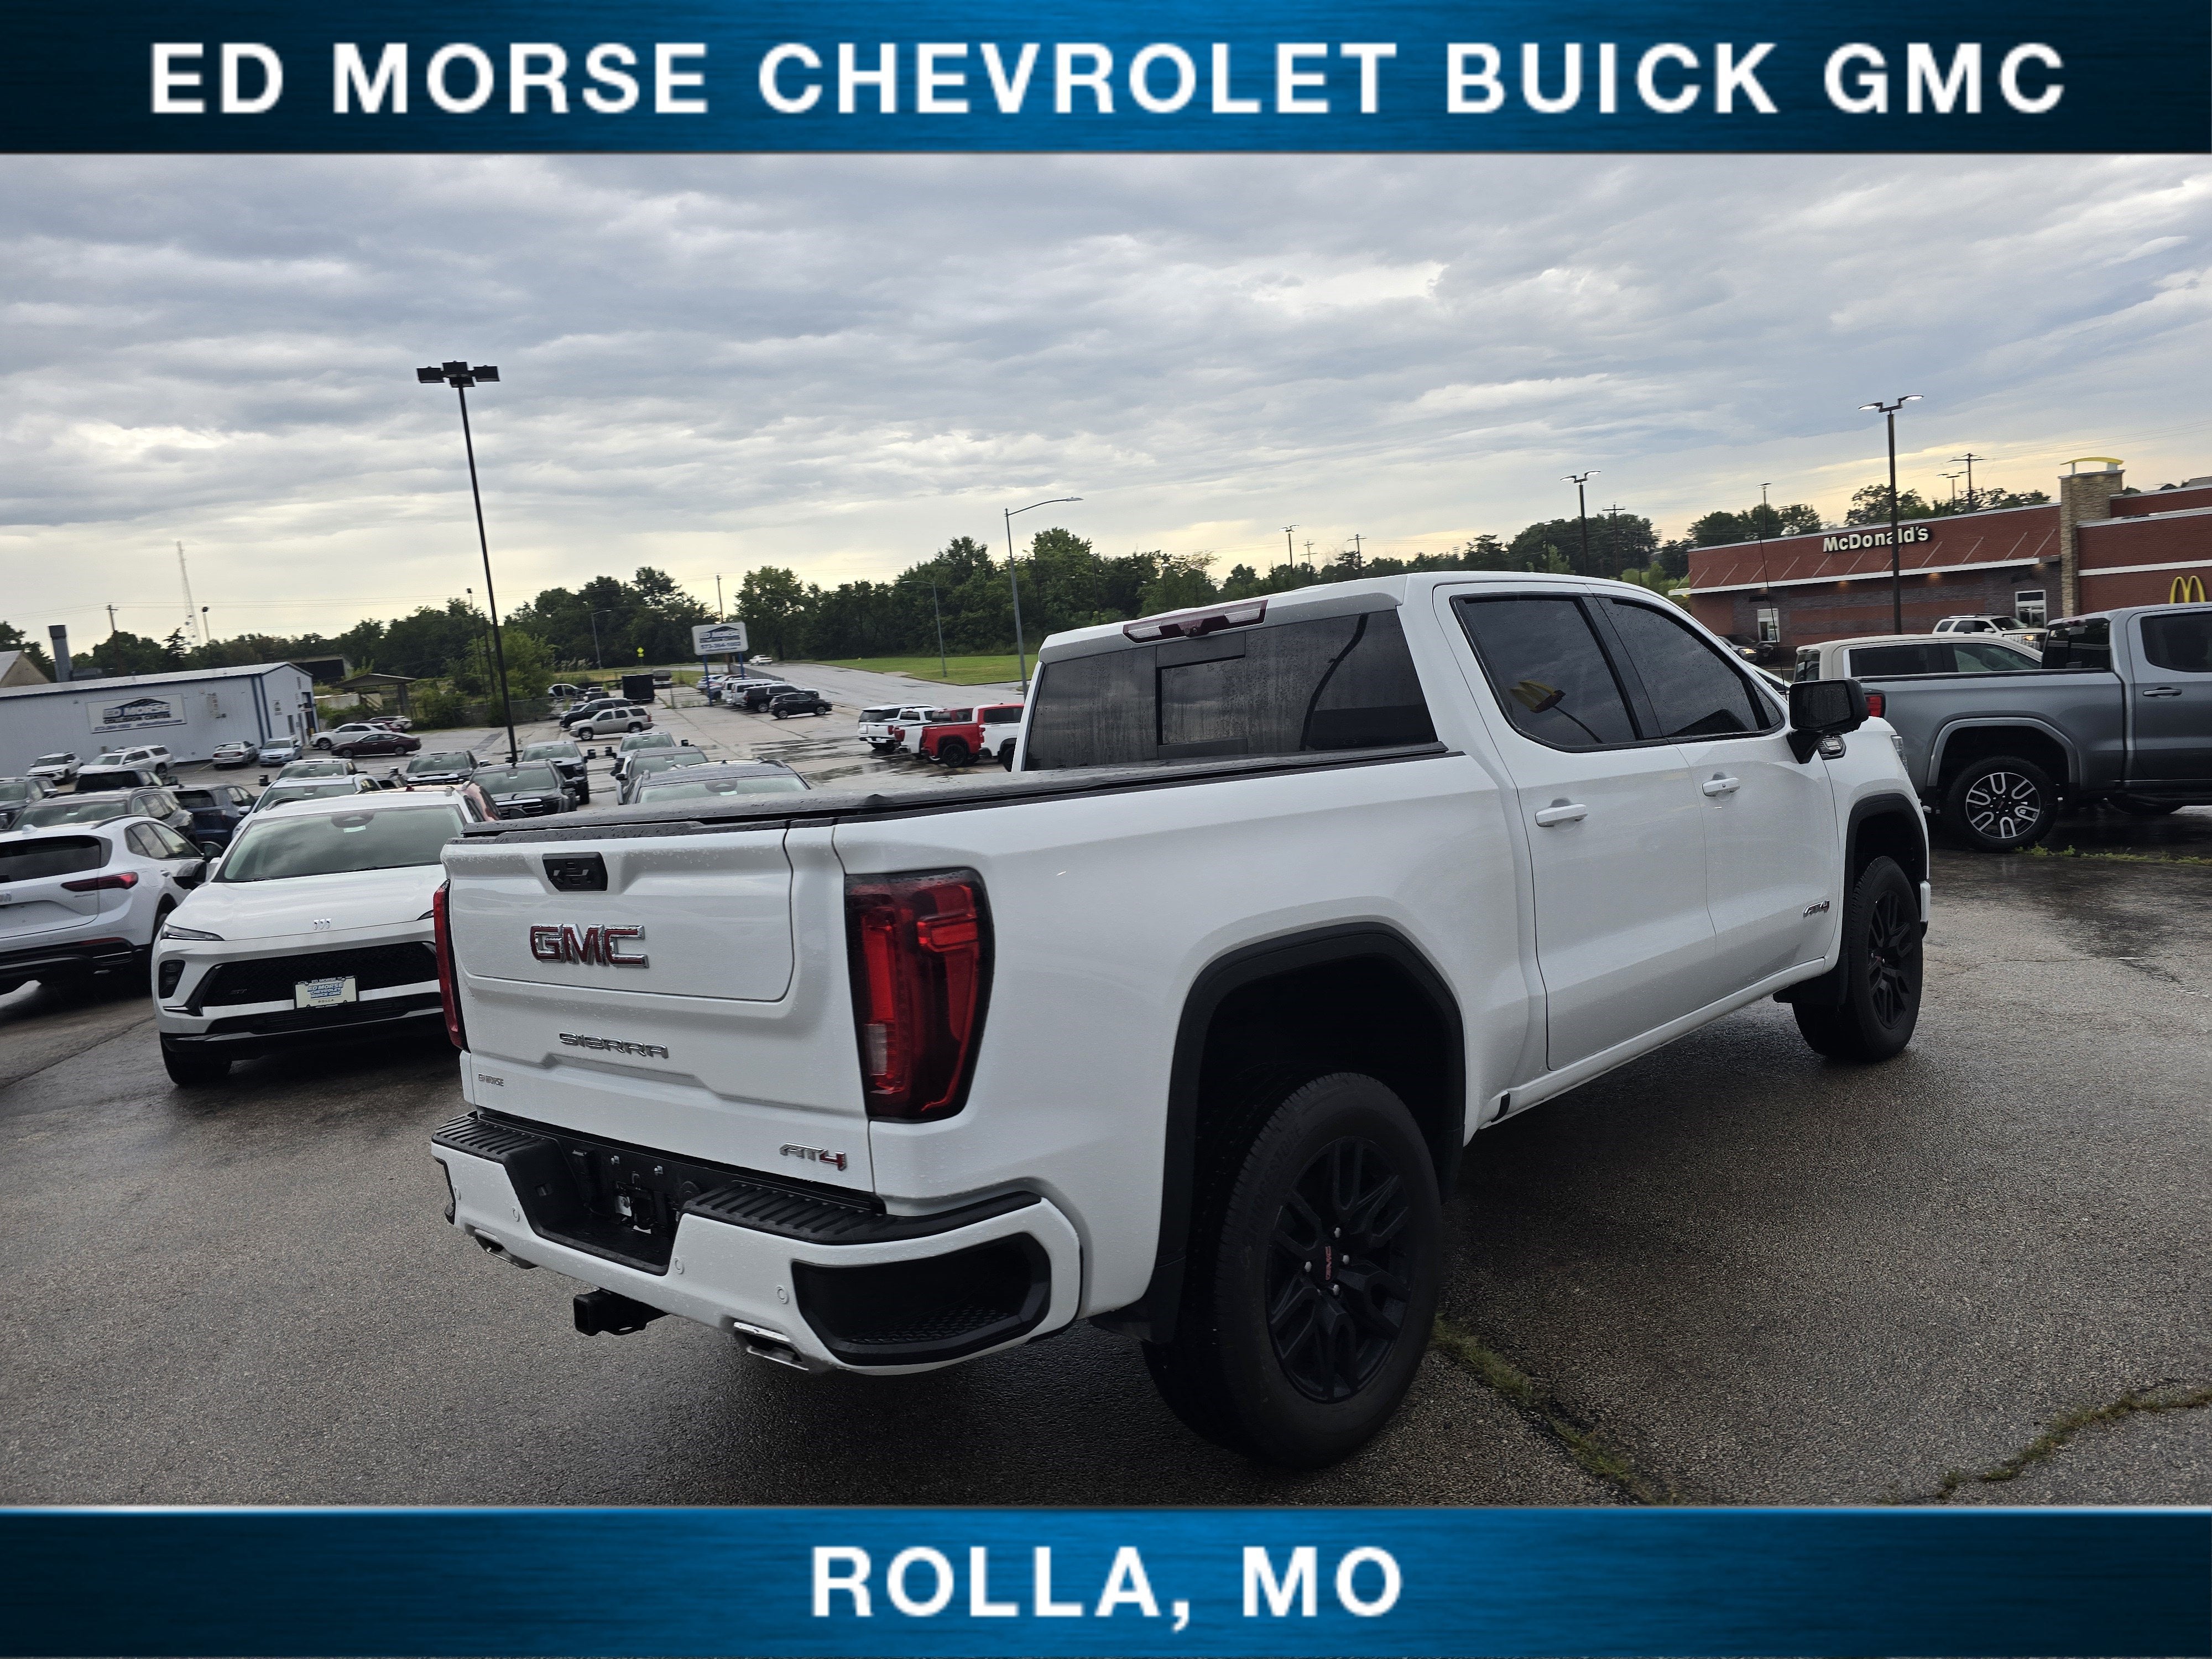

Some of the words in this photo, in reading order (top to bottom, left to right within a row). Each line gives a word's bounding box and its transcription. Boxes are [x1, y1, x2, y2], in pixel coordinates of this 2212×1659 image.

[1823, 526, 1929, 552] McDonald's
[103, 708, 122, 719] ED
[123, 703, 171, 717] MORSE
[530, 923, 649, 968] GMC
[559, 1031, 669, 1059] SIERRA
[779, 1142, 847, 1172] AT4
